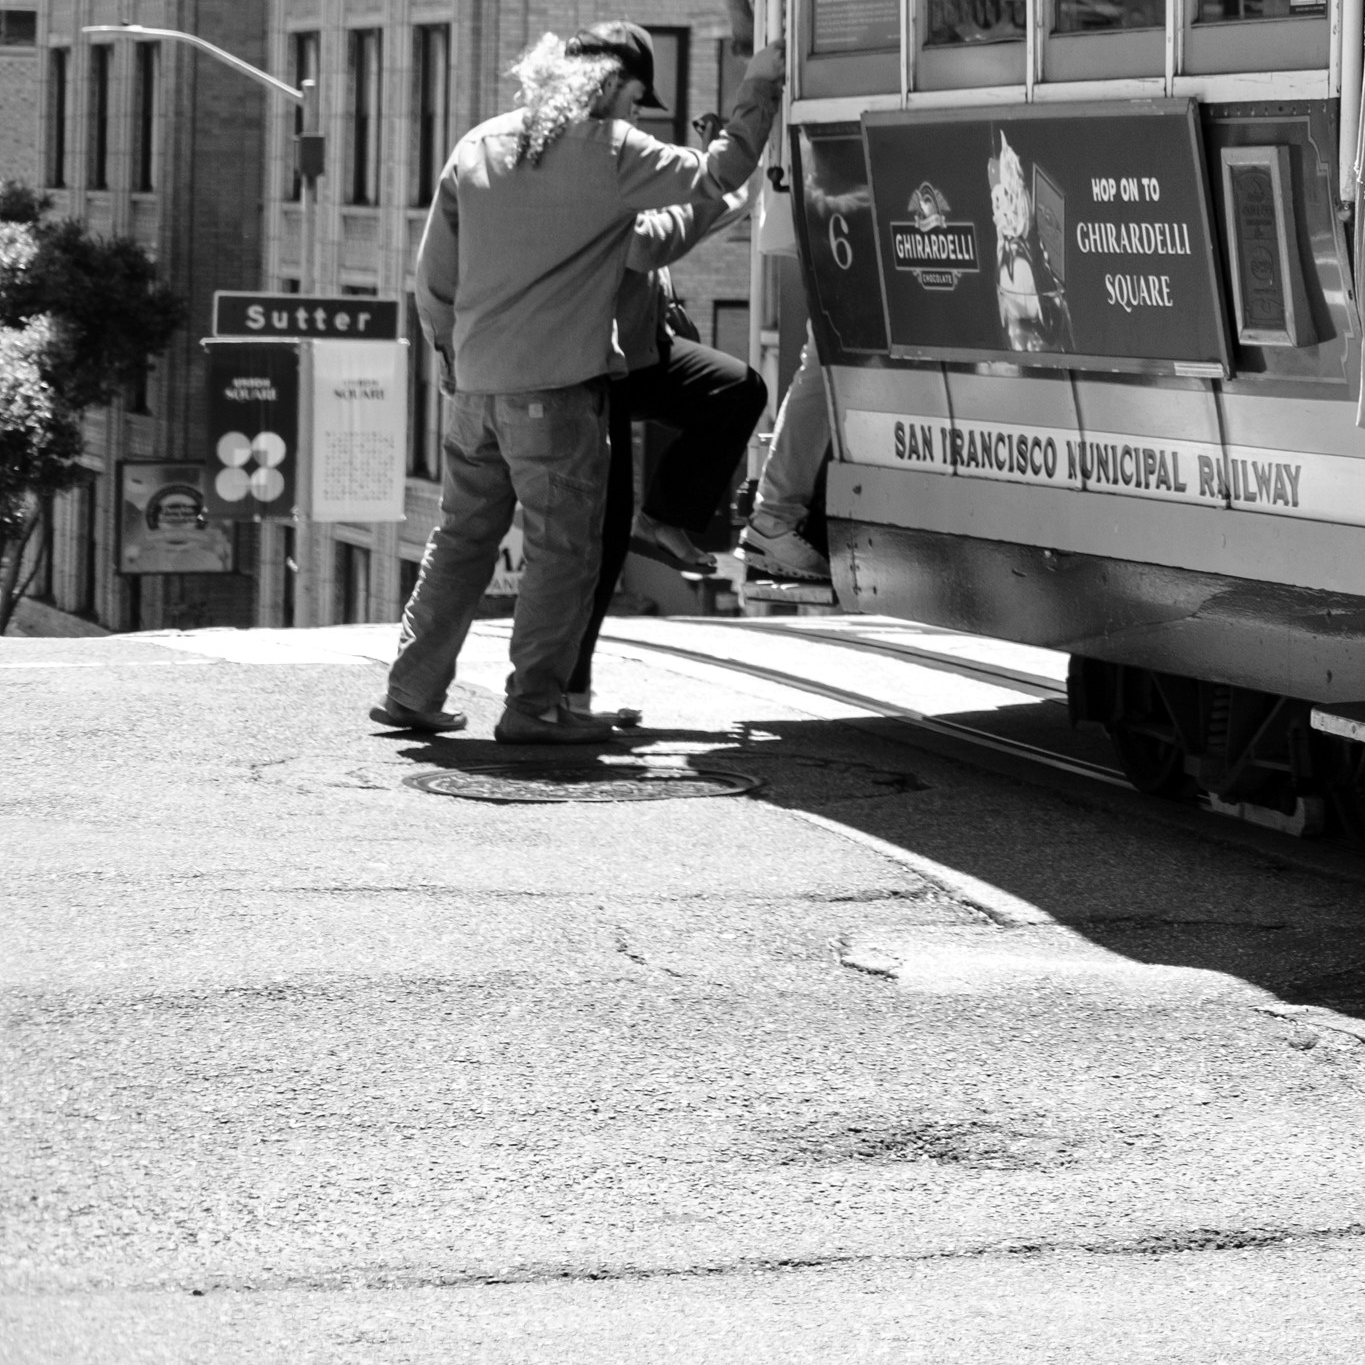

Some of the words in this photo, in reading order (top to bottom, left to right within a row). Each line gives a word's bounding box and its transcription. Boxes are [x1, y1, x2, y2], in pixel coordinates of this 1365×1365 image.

[1091, 177, 1116, 203] HOP
[1121, 177, 1137, 202] ON
[1141, 177, 1160, 202] TO
[829, 214, 853, 270] 6
[896, 234, 974, 260] GHIRARDELLI
[1076, 221, 1191, 255] GHIRARDELLI
[1105, 274, 1174, 312] SQUARE
[246, 306, 372, 332] Sutter
[894, 421, 934, 462] SAN
